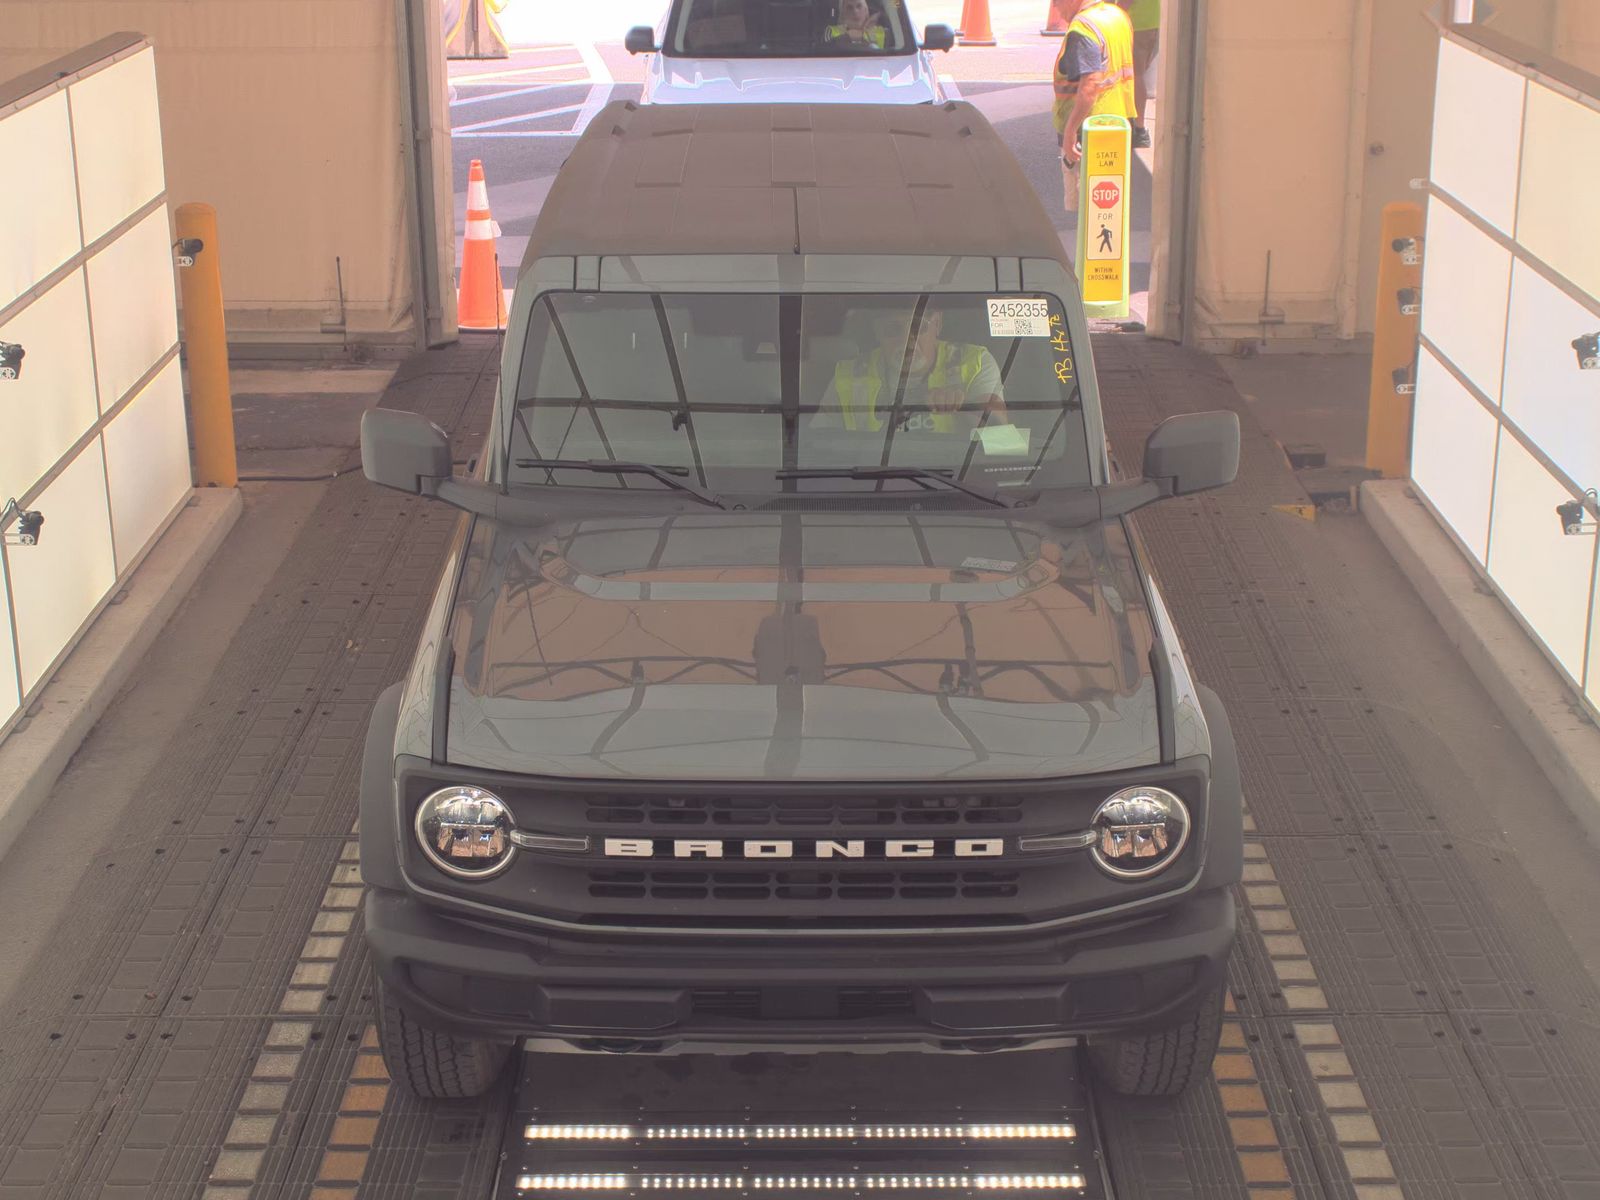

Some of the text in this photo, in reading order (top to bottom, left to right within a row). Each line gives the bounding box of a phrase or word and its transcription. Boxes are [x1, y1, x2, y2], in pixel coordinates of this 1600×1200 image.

[1096, 151, 1119, 159] STATE
[1093, 189, 1119, 201] STOP
[1097, 212, 1113, 221] FOR
[1087, 273, 1120, 281] CROSSWALK
[990, 303, 1049, 318] 2452355
[604, 838, 1004, 858] BRONCO
